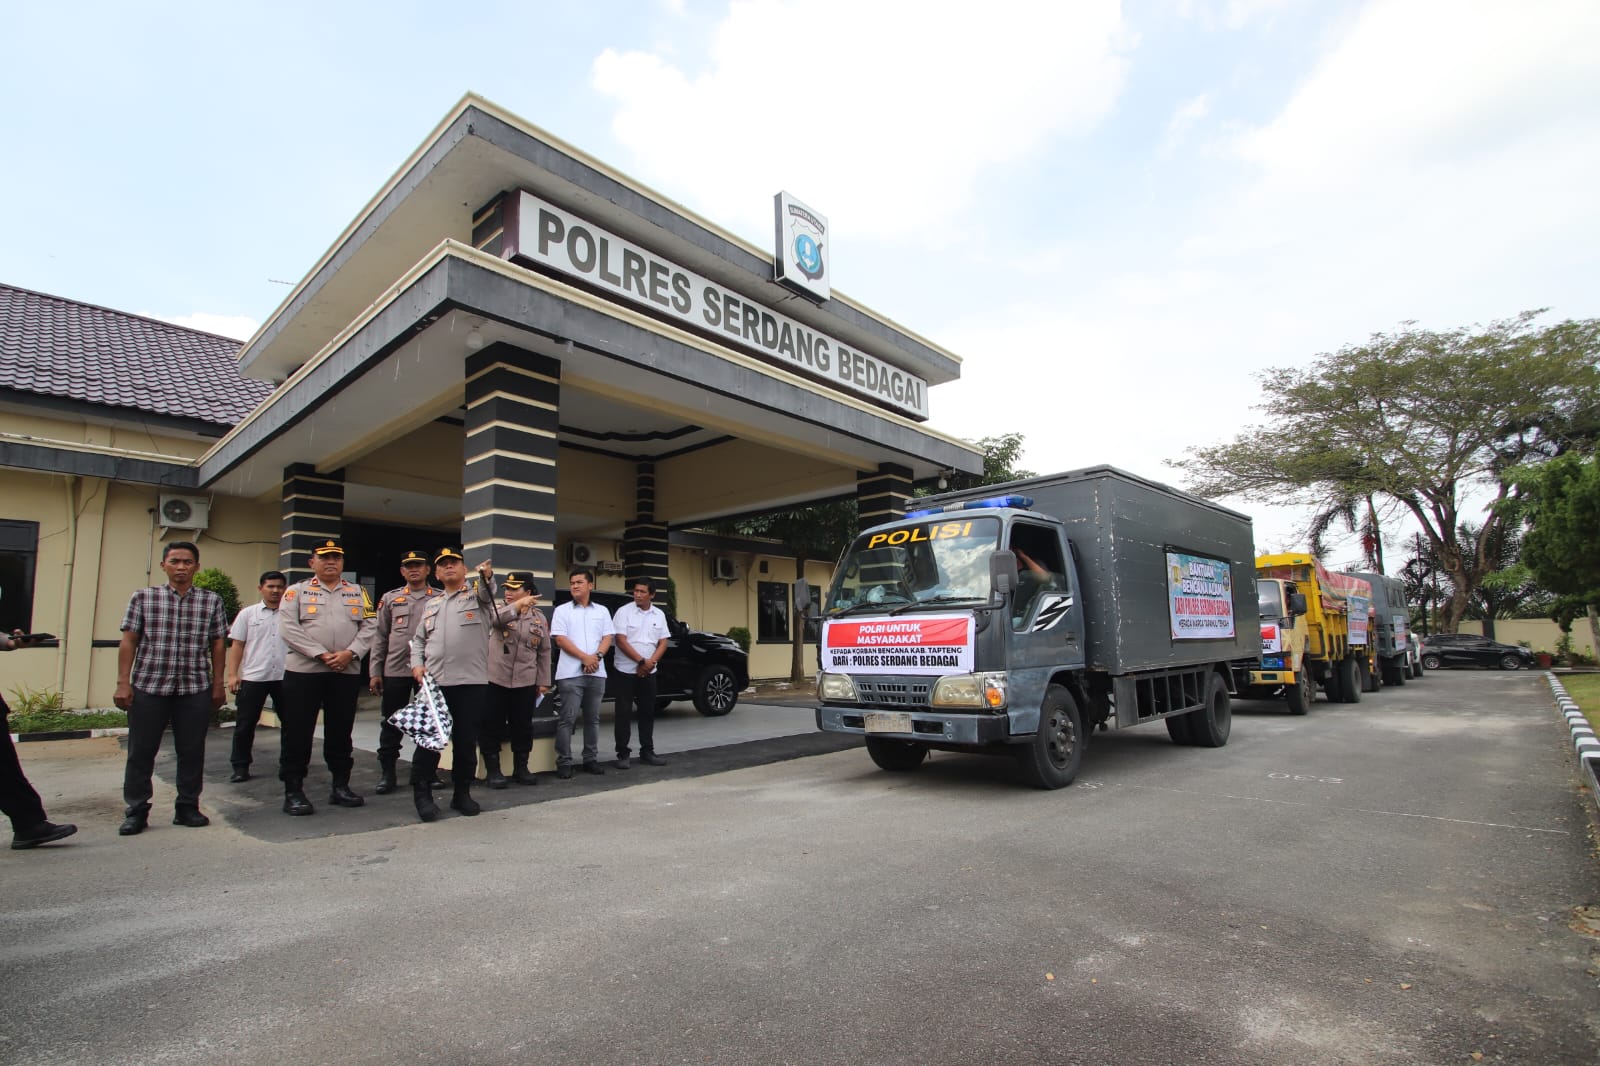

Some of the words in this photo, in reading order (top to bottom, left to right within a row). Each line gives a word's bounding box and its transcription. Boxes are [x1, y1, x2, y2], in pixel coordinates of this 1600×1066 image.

[538, 207, 692, 314] POLRES
[702, 286, 830, 371] SERDANG
[838, 346, 922, 410] BEDAGAI
[868, 522, 972, 548] POLISI
[859, 624, 885, 634] POLRI
[886, 623, 921, 633] UNTUK
[857, 634, 923, 645] MASYARAKAT
[833, 656, 848, 666] DARI
[853, 656, 879, 667] POLRES
[881, 656, 917, 667] SERDANG
[920, 655, 959, 667] BEDAGAI
